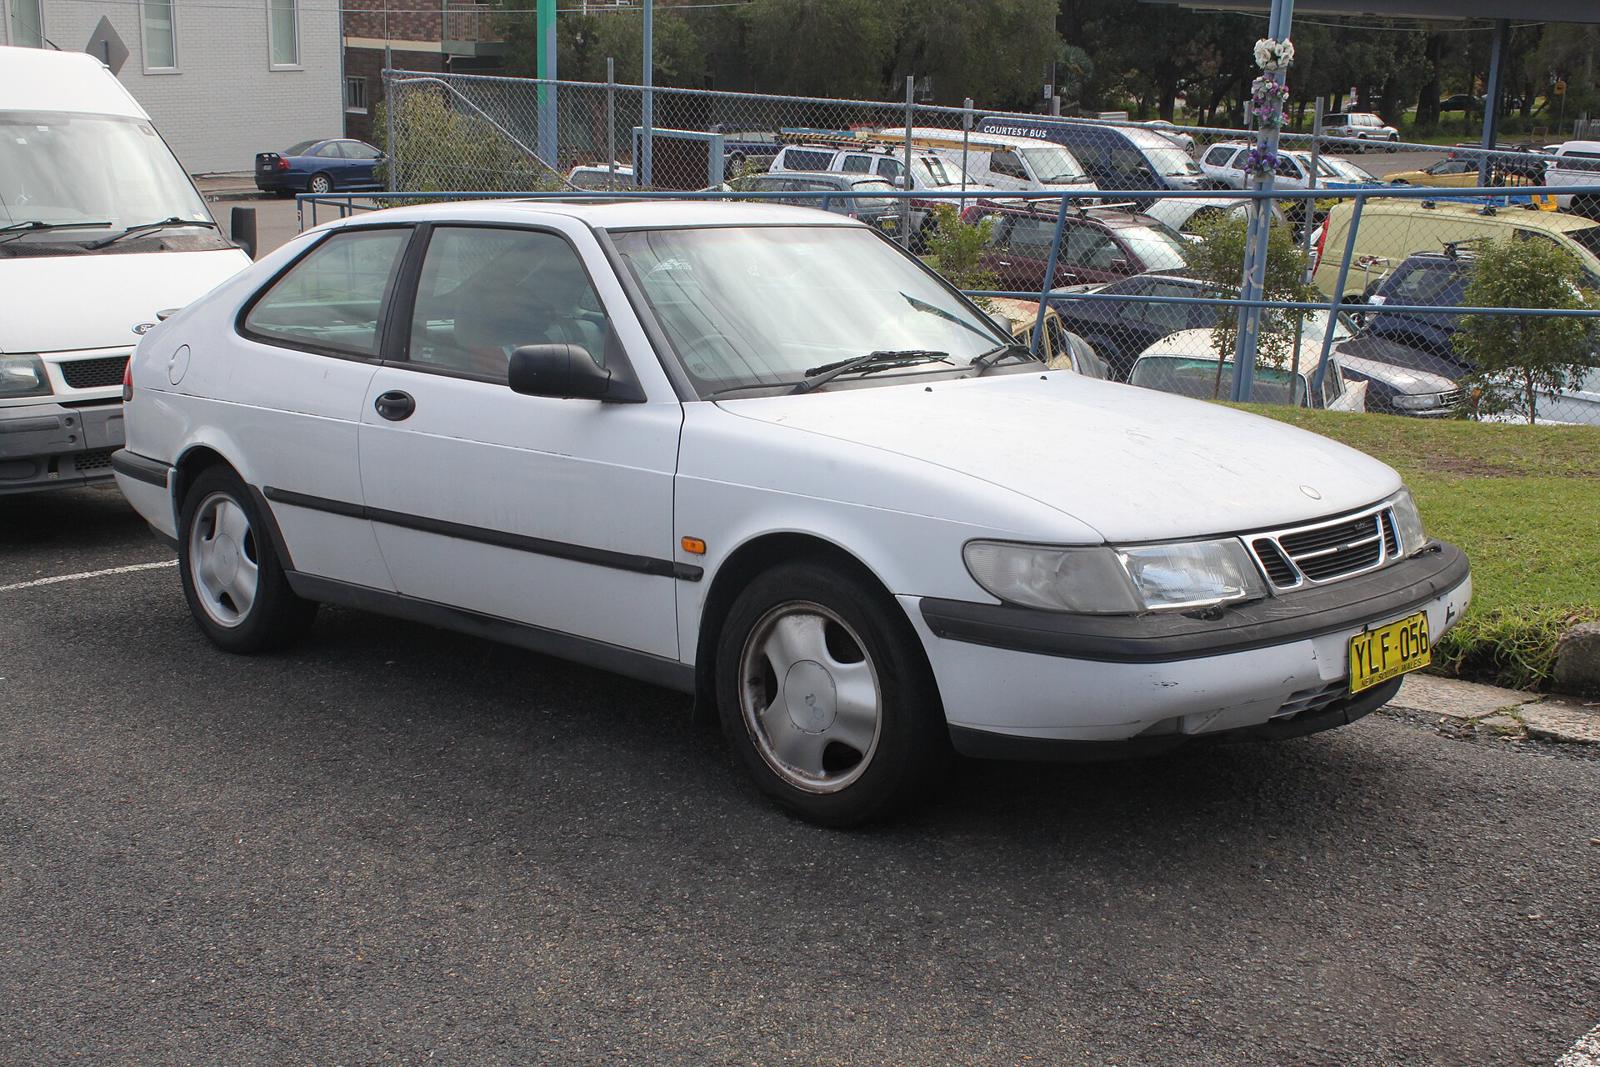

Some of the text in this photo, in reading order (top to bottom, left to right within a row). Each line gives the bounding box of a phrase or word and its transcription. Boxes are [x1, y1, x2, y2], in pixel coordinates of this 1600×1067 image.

[983, 125, 1047, 138] COURTESY BUS
[1361, 658, 1422, 686] NEW SOUTH WALES
